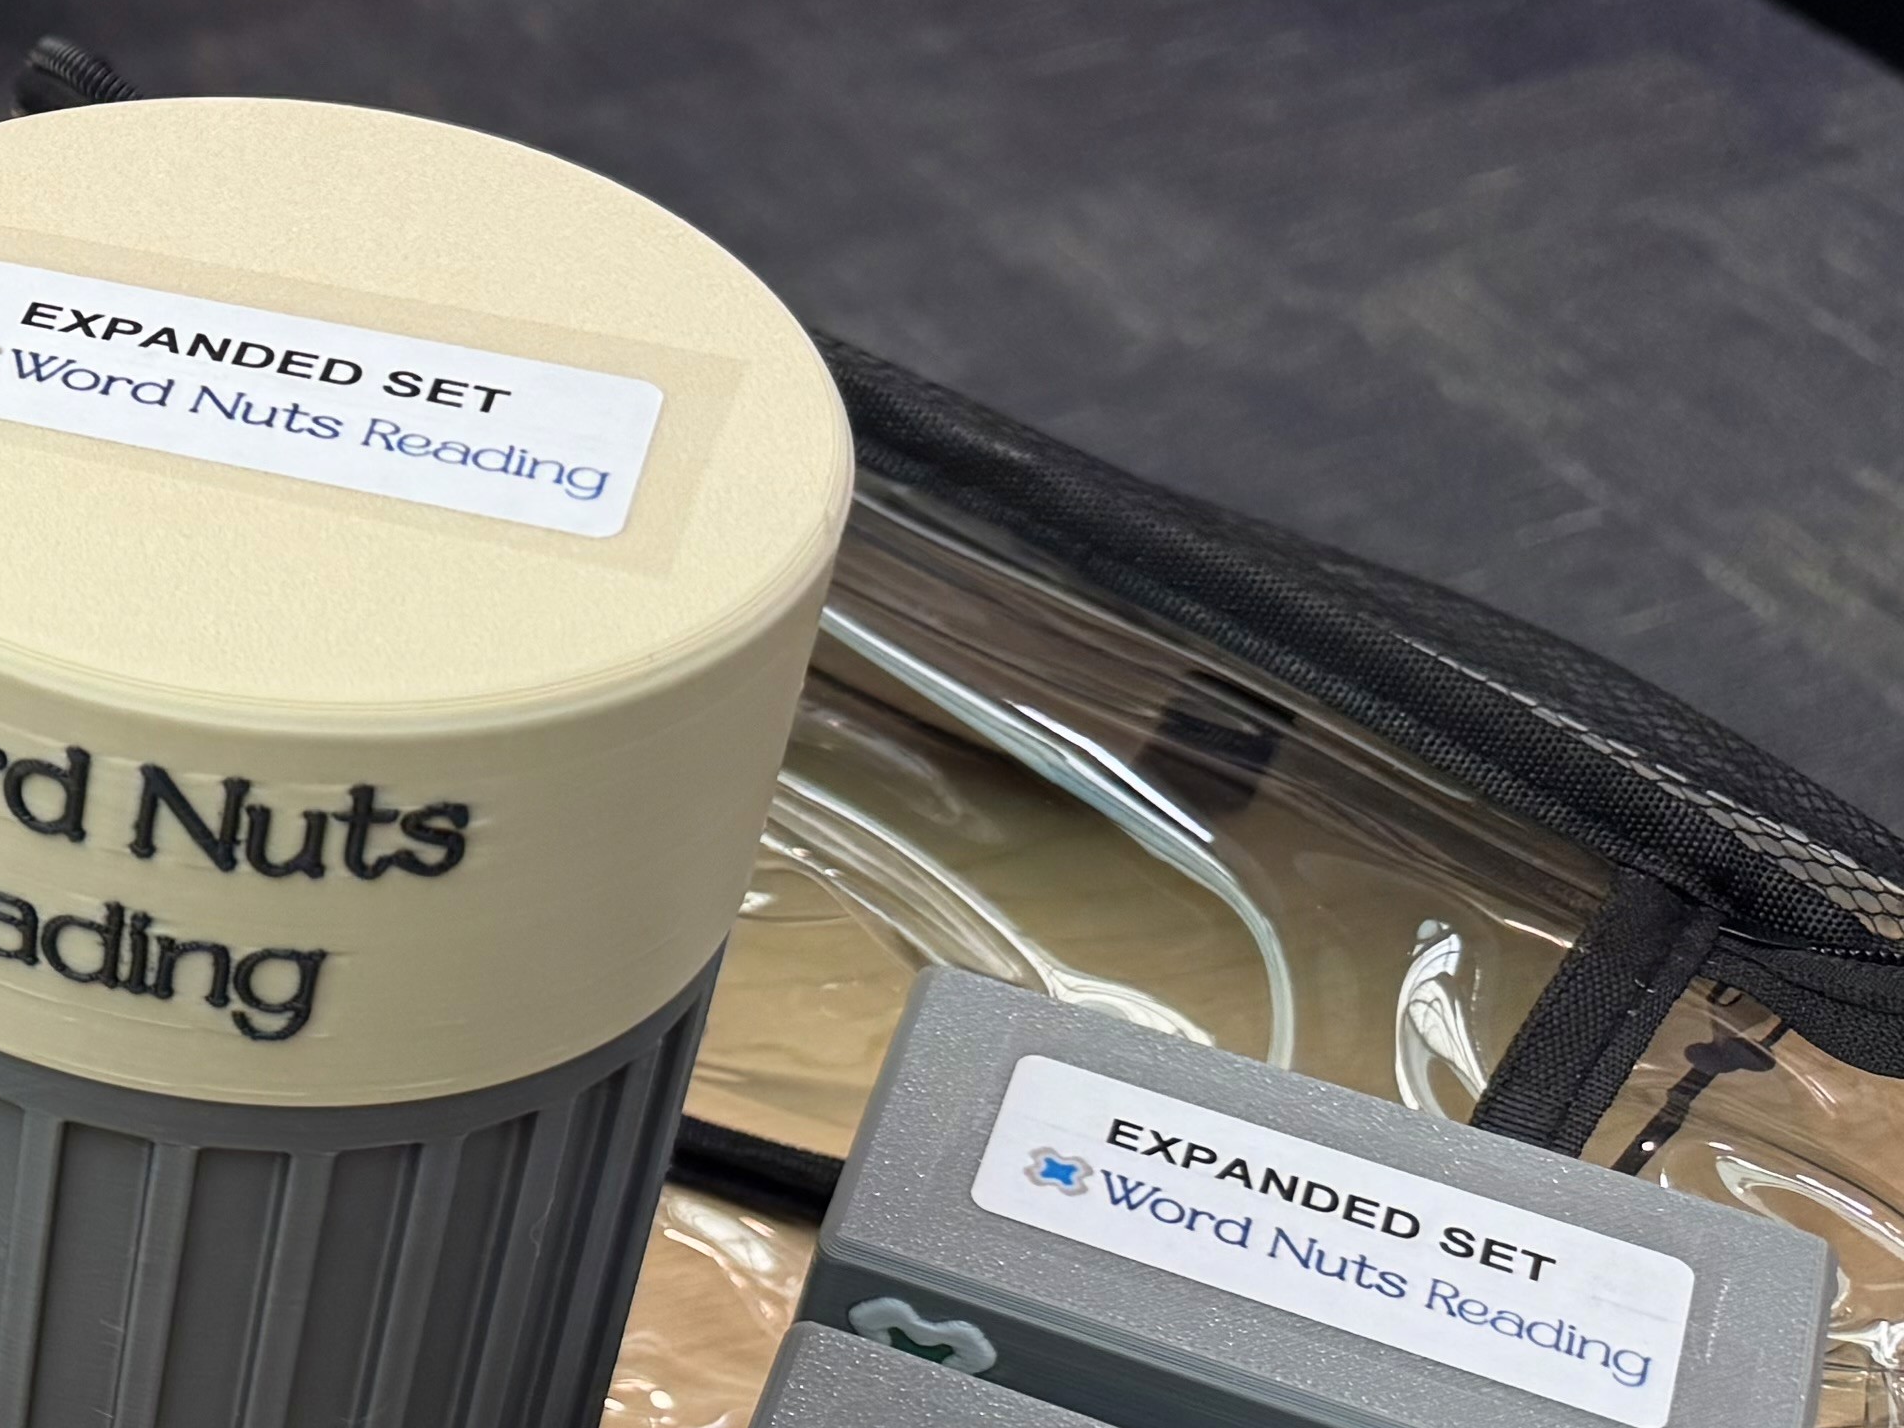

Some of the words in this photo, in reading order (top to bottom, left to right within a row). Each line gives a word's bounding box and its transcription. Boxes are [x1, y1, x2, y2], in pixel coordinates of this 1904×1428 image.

[8, 345, 176, 409] Word
[188, 385, 346, 443] Nuts
[360, 417, 612, 502] Reading
[19, 301, 365, 390] EXPANDED
[381, 369, 513, 415] SET
[127, 762, 471, 882] Nuts
[1099, 1168, 1253, 1250] Word
[1266, 1226, 1410, 1300] Nuts
[1423, 1277, 1653, 1388] Reading
[1104, 1117, 1422, 1242] EXPANDED
[1437, 1225, 1558, 1283] SET
